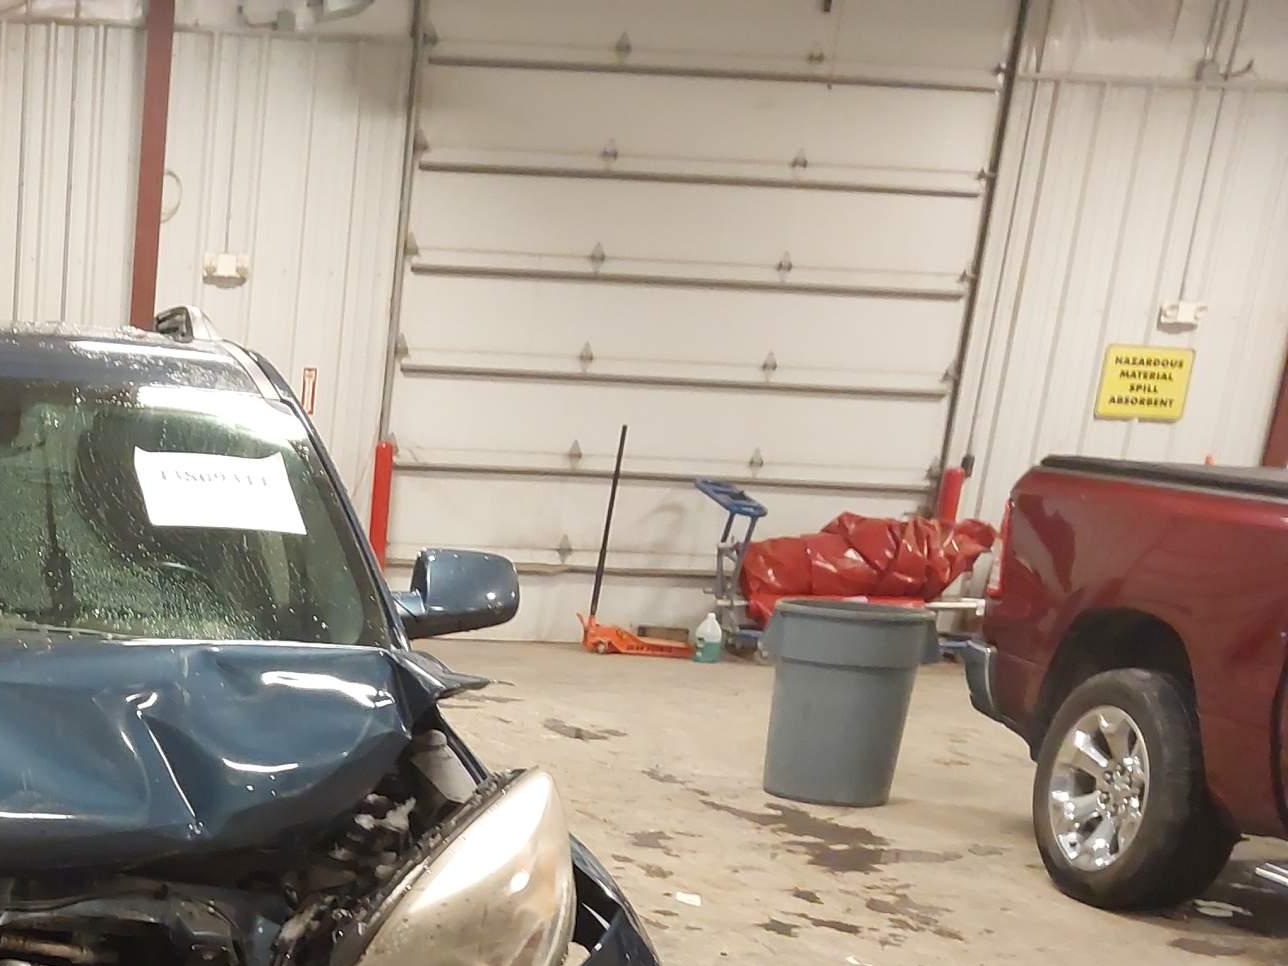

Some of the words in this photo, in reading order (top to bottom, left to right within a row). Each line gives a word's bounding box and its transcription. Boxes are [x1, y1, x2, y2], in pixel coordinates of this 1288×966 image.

[1114, 356, 1184, 369] HAZARDOUS
[1119, 369, 1174, 381] MATERIAL
[1129, 383, 1159, 394] SPILL
[1108, 396, 1175, 408] ABSORBENT
